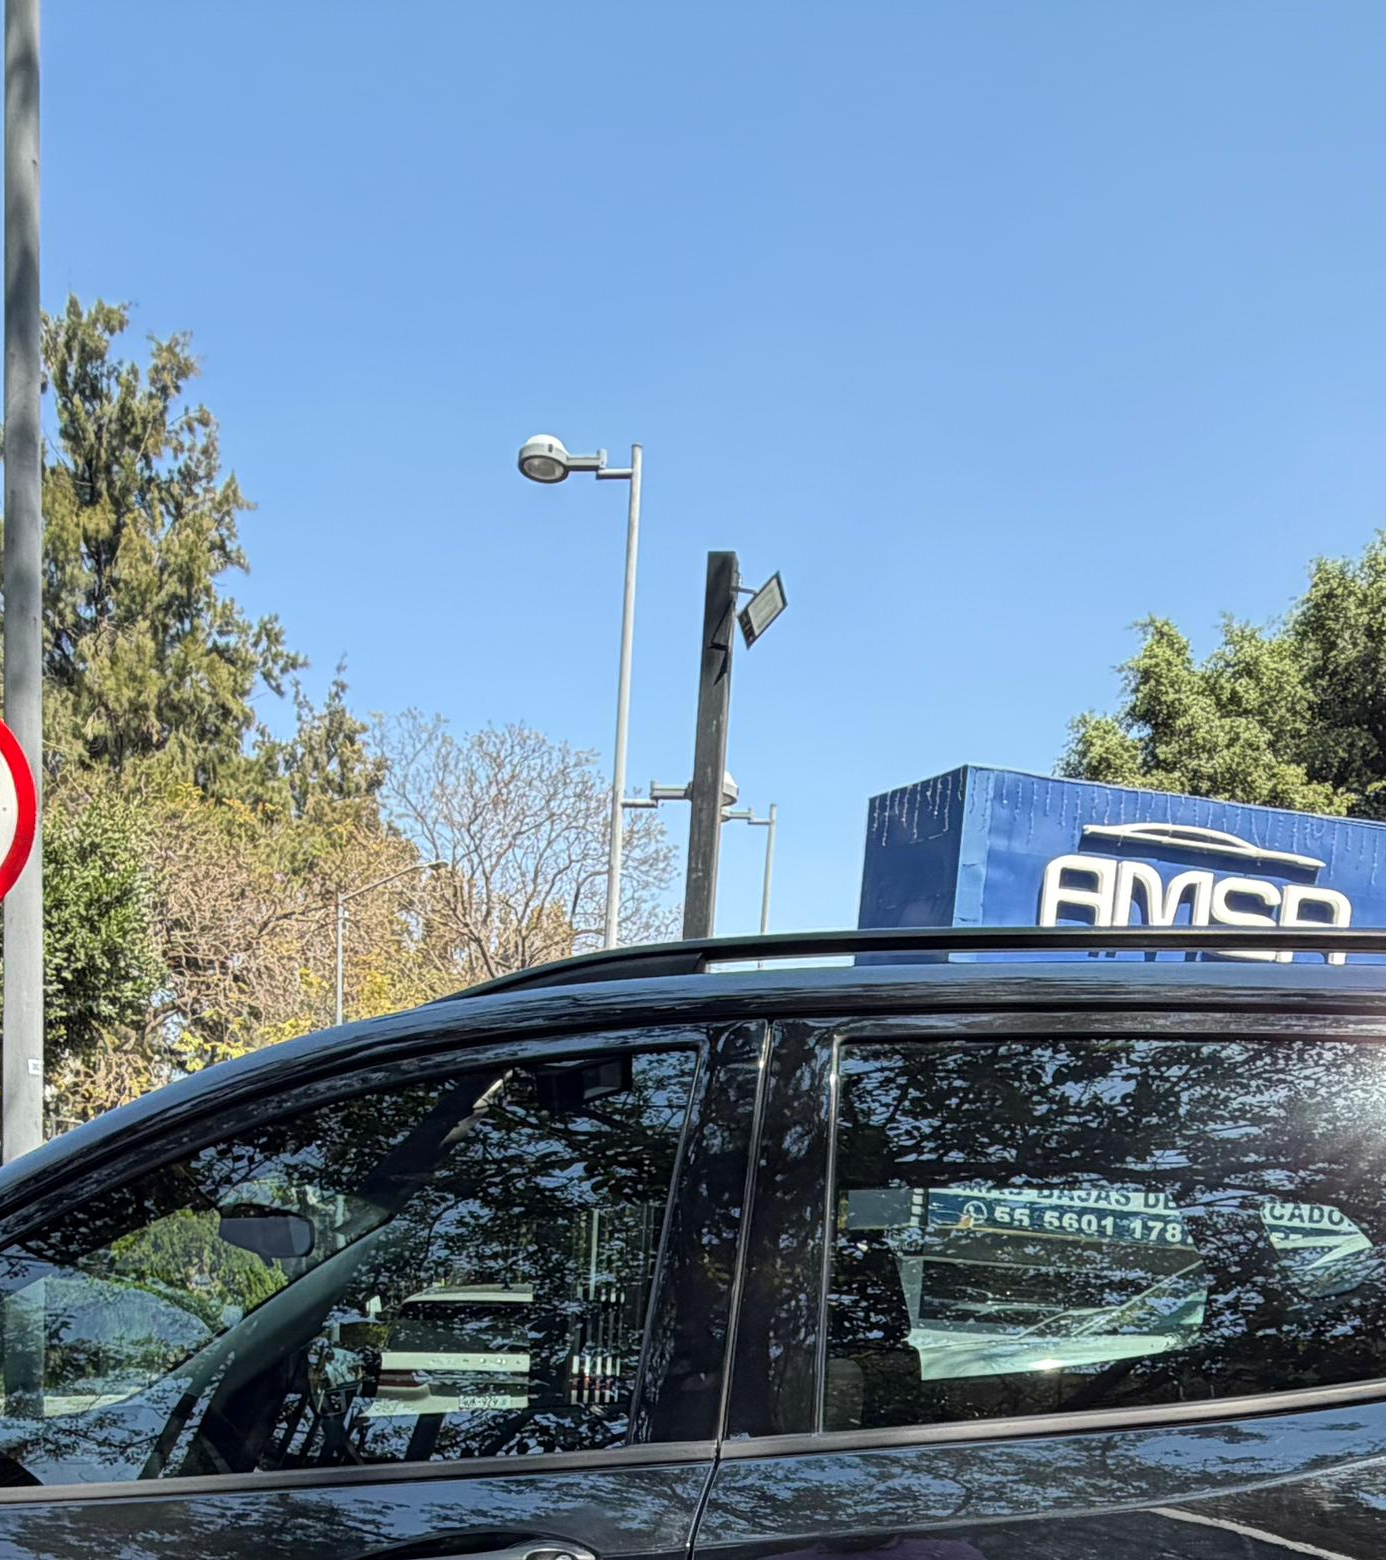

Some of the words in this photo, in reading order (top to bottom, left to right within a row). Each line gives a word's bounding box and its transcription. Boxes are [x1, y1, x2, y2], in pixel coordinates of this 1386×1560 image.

[994, 1206, 1031, 1226] 55
[1043, 1209, 1114, 1236] 5601
[1261, 1204, 1354, 1227] CADO
